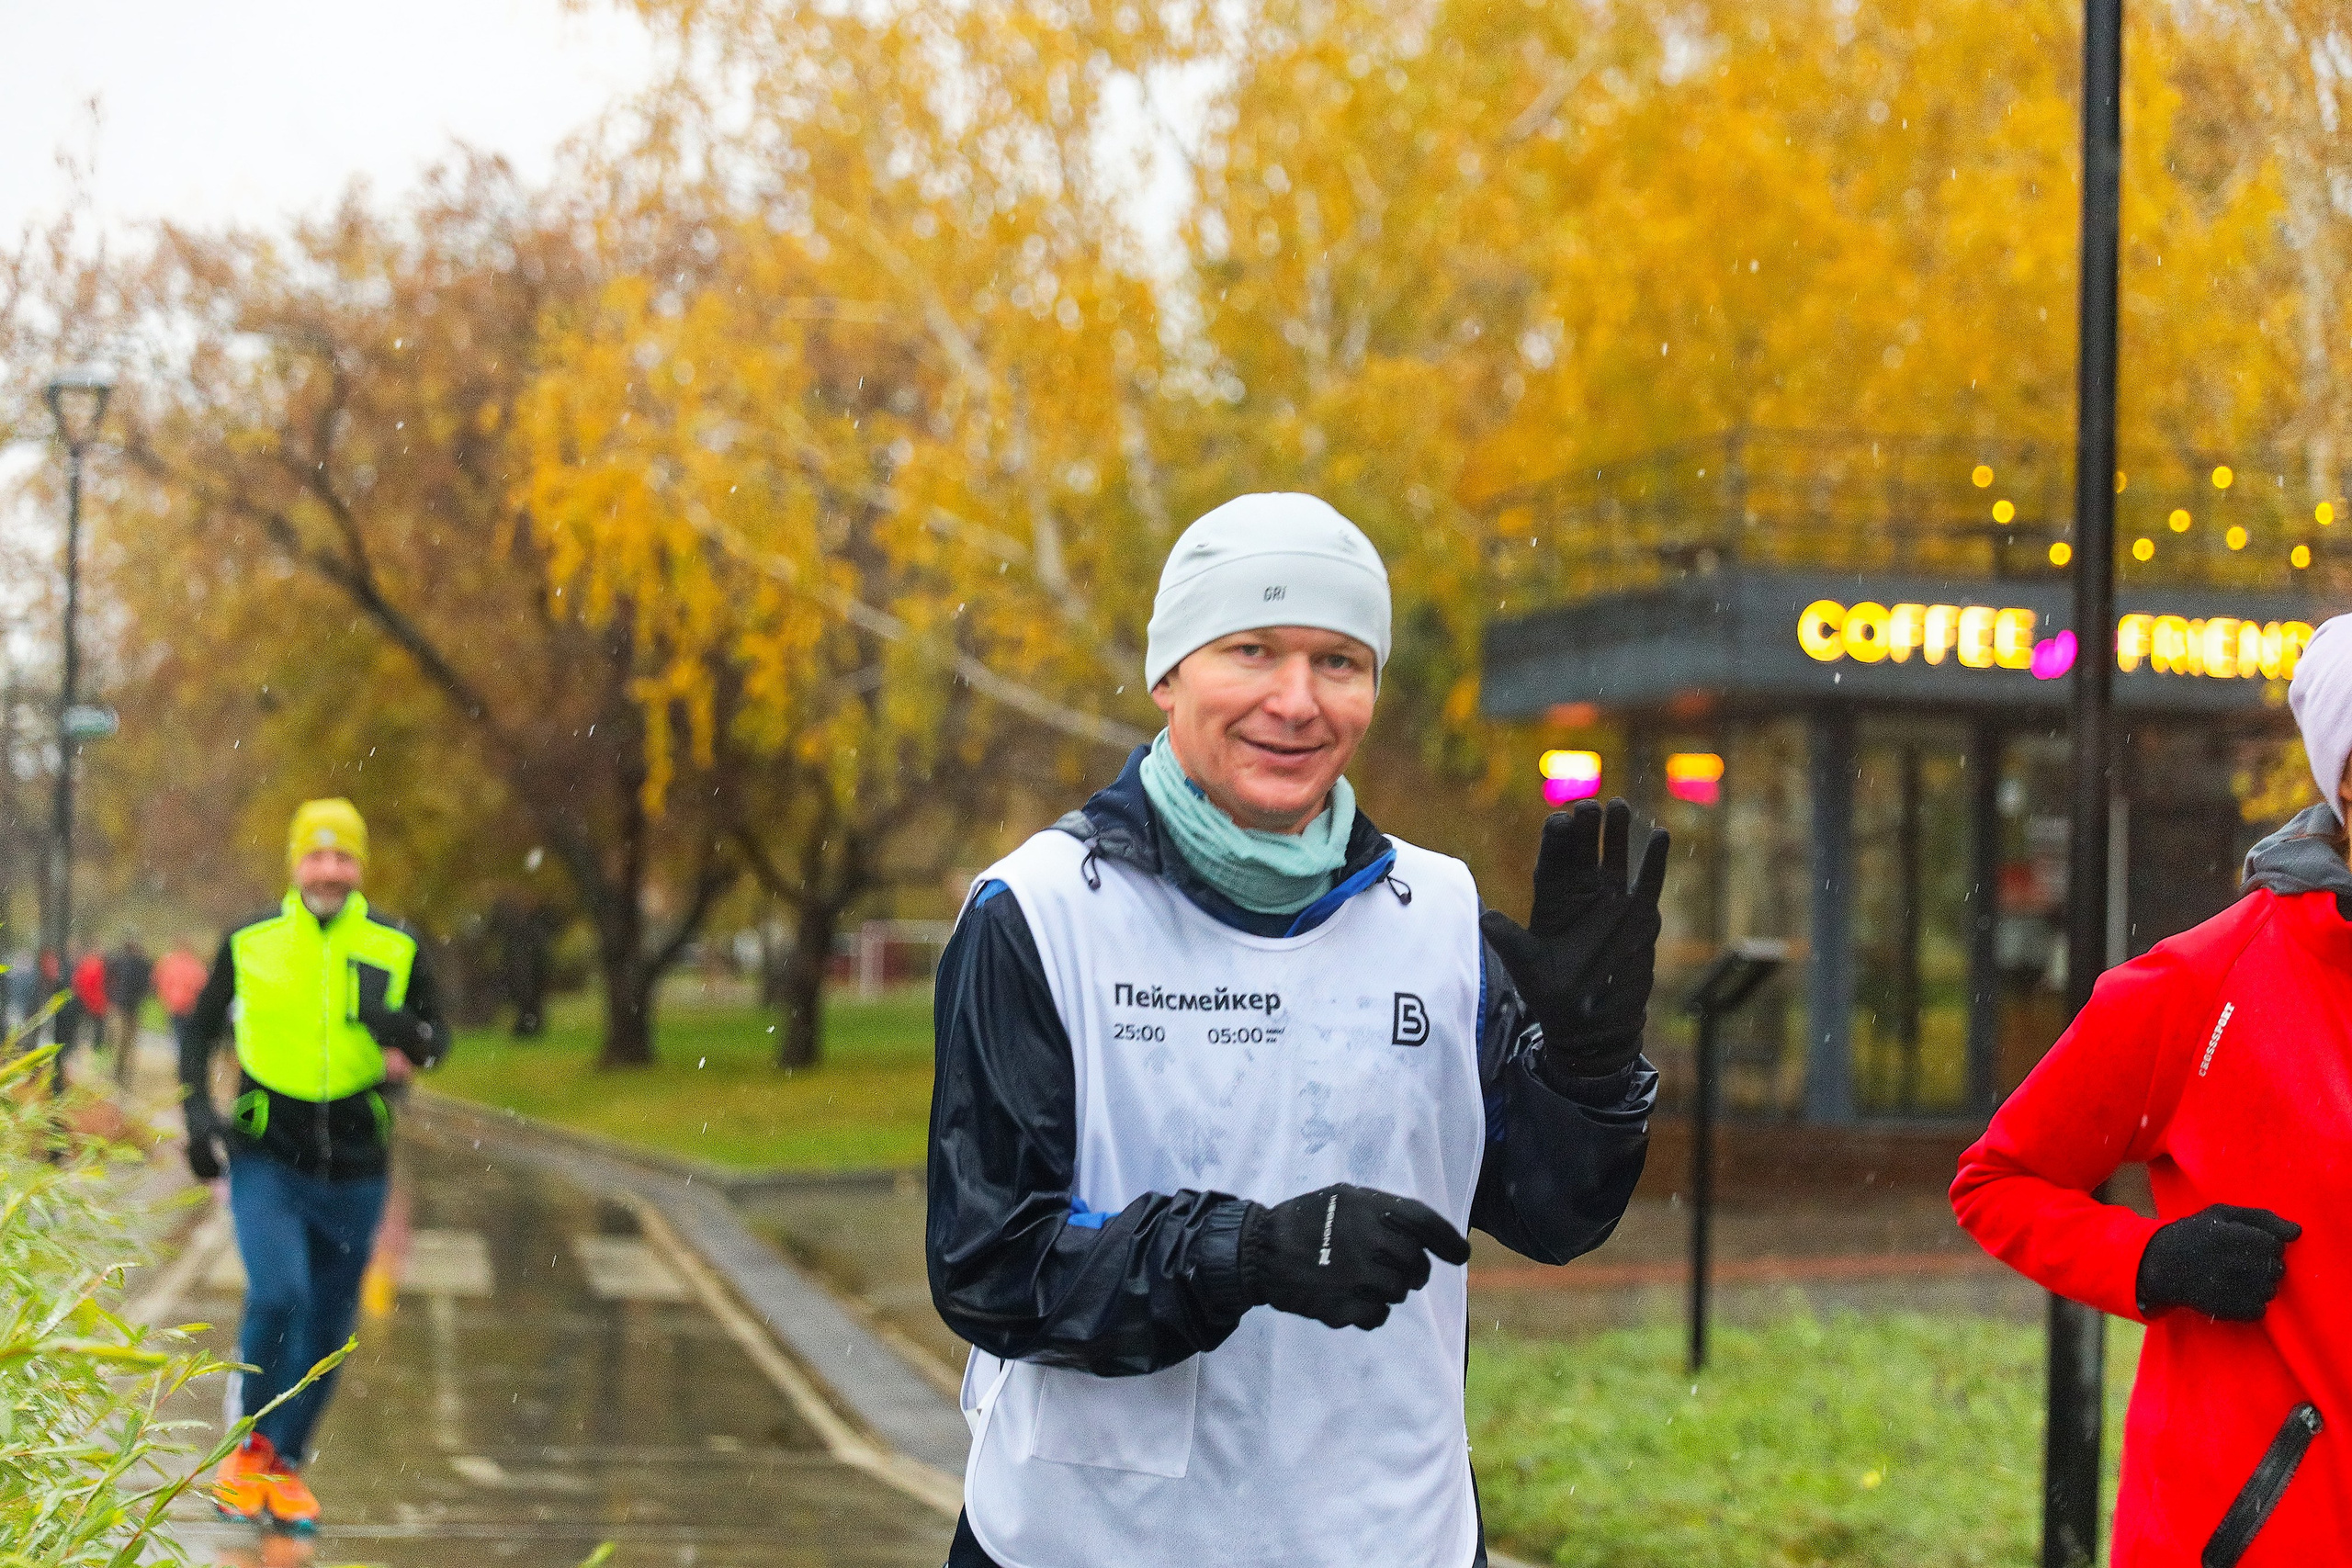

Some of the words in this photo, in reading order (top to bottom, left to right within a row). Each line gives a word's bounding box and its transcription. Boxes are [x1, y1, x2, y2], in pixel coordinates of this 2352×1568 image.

[1797, 600, 2035, 670] COFFEE
[1114, 983, 1282, 1016] Пейсмейкер
[1114, 1023, 1166, 1043] 25:00
[1207, 1027, 1263, 1044] 05:00
